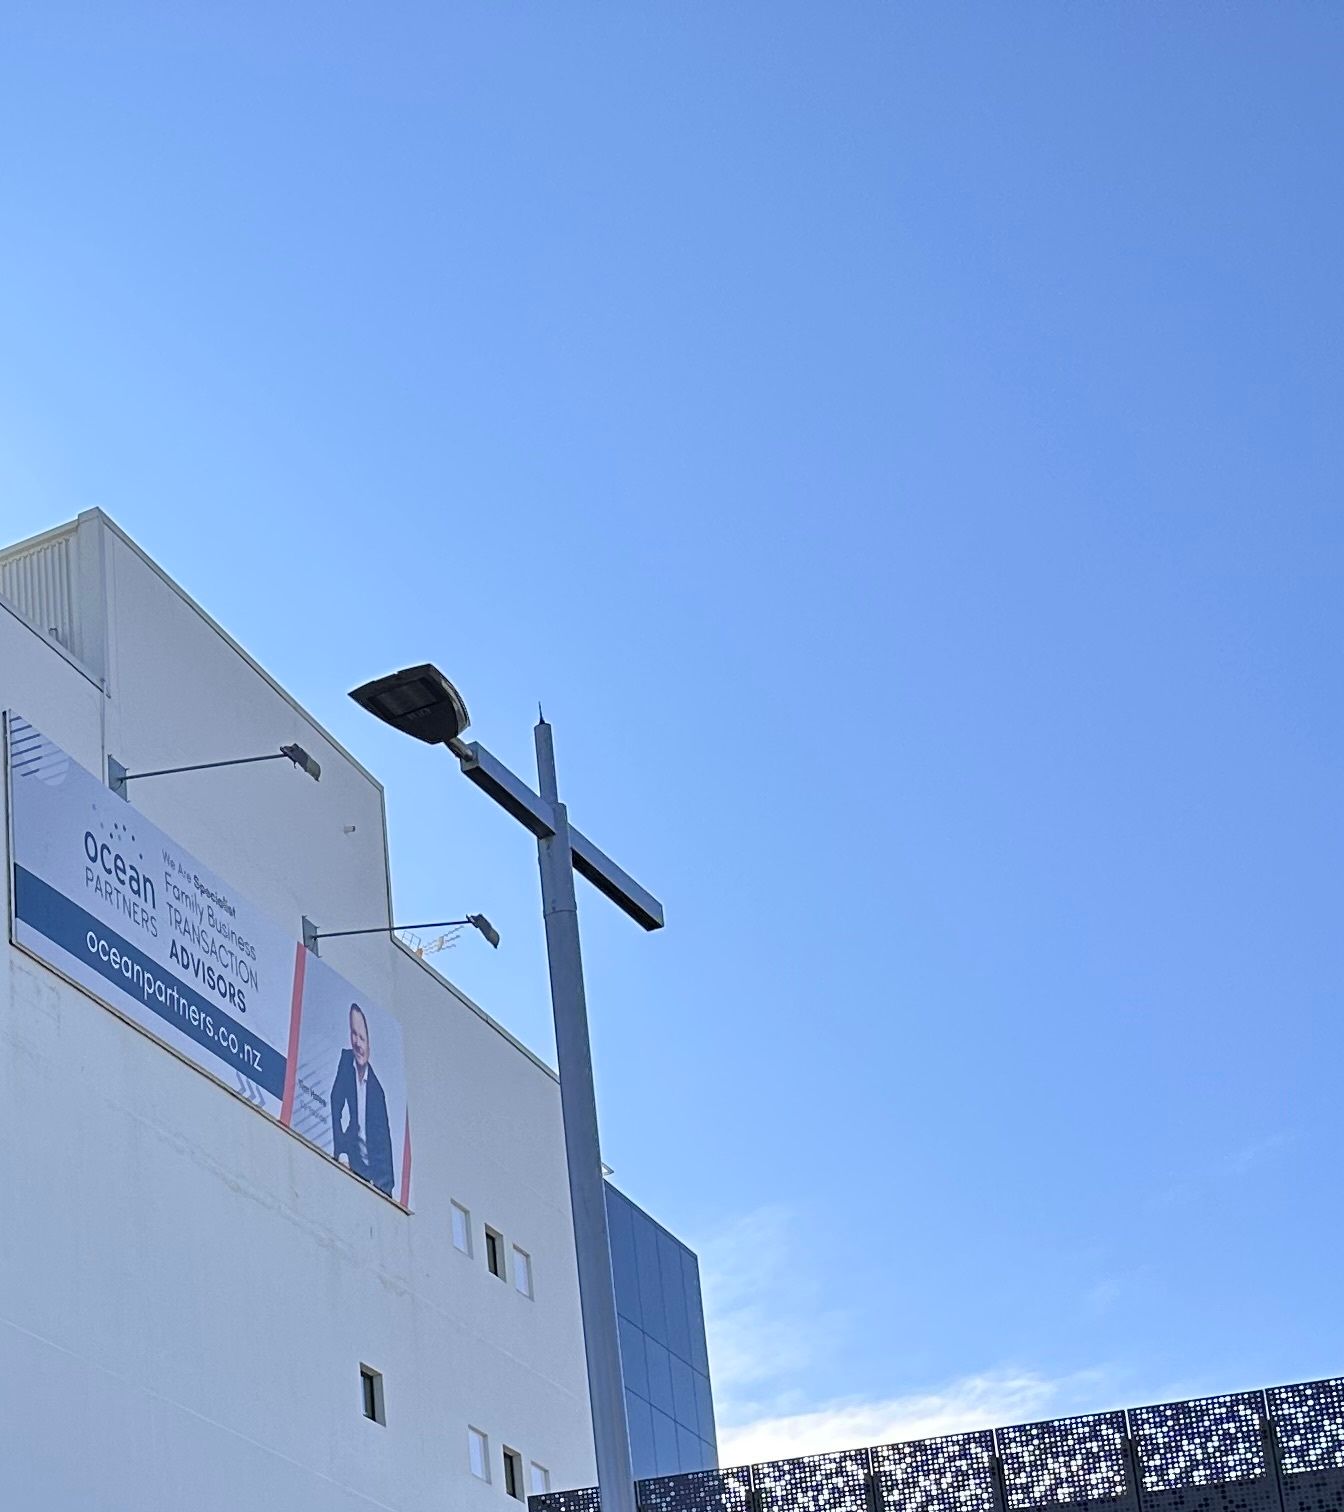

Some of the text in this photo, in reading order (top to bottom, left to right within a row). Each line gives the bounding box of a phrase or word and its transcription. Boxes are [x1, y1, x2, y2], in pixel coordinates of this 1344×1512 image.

[84, 831, 156, 910] ocean
[85, 866, 158, 938] PARTNERS
[162, 849, 175, 870] We
[178, 864, 191, 884] Are
[165, 872, 257, 961] Family Business
[166, 902, 259, 993] TRANSACTION
[86, 931, 263, 1072] oceanpartners.co.nz
[169, 939, 247, 1013] ADVISORS
